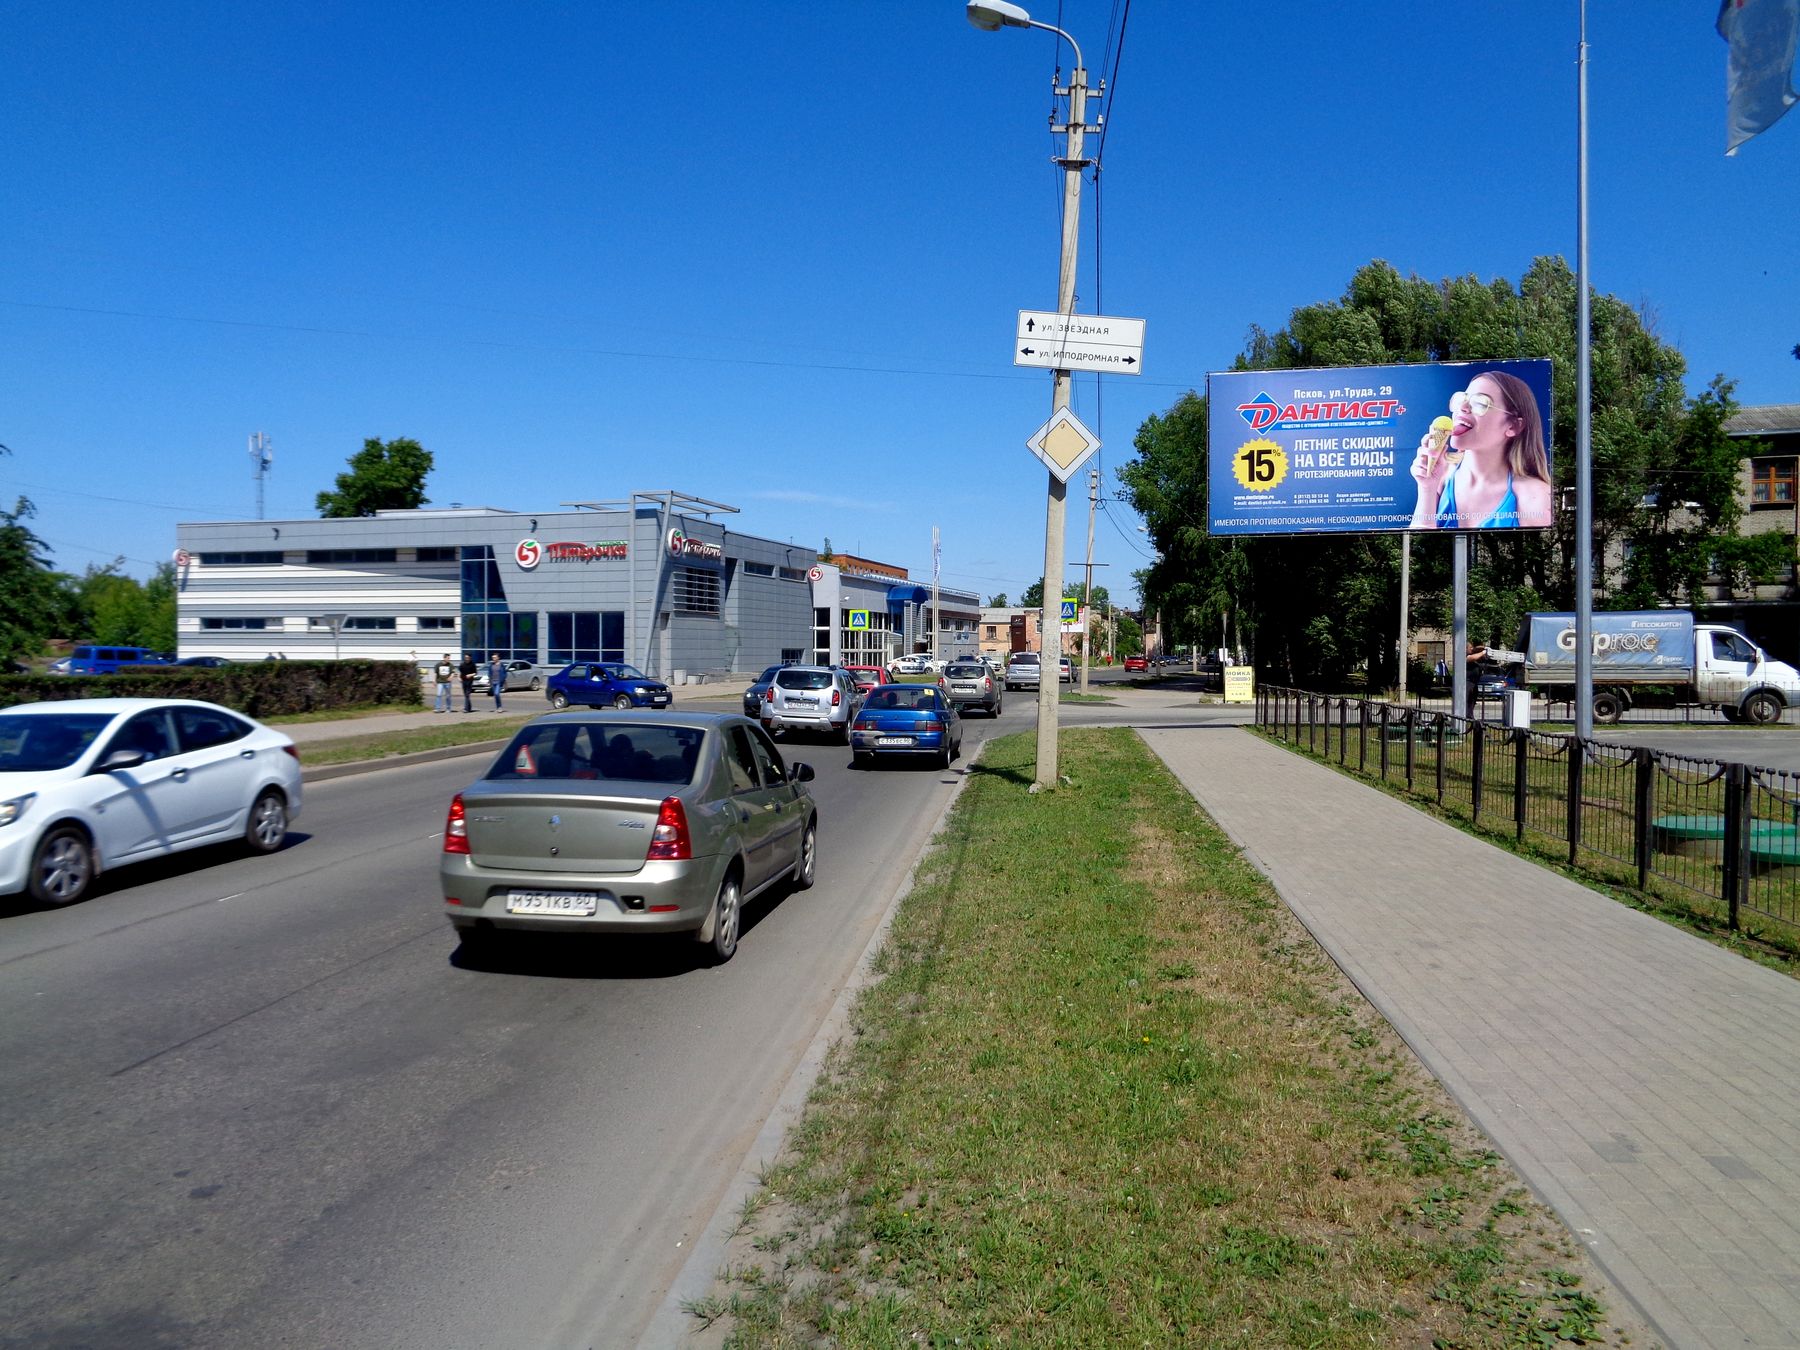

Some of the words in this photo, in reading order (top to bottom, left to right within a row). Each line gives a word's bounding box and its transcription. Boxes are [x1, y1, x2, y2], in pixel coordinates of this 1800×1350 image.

[1058, 324, 1109, 335] ЗВЕЗДНАЯ
[1053, 350, 1120, 362] ИППОДРОМНАЯ
[1294, 389, 1326, 399] Псков,
[1330, 387, 1376, 398] ул.Труда,
[1380, 386, 1392, 396] 29
[1294, 438, 1338, 451] ЛЕТНИЕ
[1342, 436, 1394, 450] СКИДКИ!
[1295, 454, 1314, 468] НА
[1318, 452, 1345, 466] ВСЕ
[1350, 451, 1394, 467] ВИДЫ
[1294, 469, 1365, 479] ПРОТЕЗИРОВАНИЯ
[1368, 468, 1394, 477] ЗУБОВ
[1214, 518, 1248, 526] ИМЕЮТСЯ
[1250, 517, 1326, 526] ПРОТИВОПОКАЗАНИЯ,
[1328, 516, 1376, 524] НЕОБХОДИМО
[1556, 628, 1658, 656] Gproc
